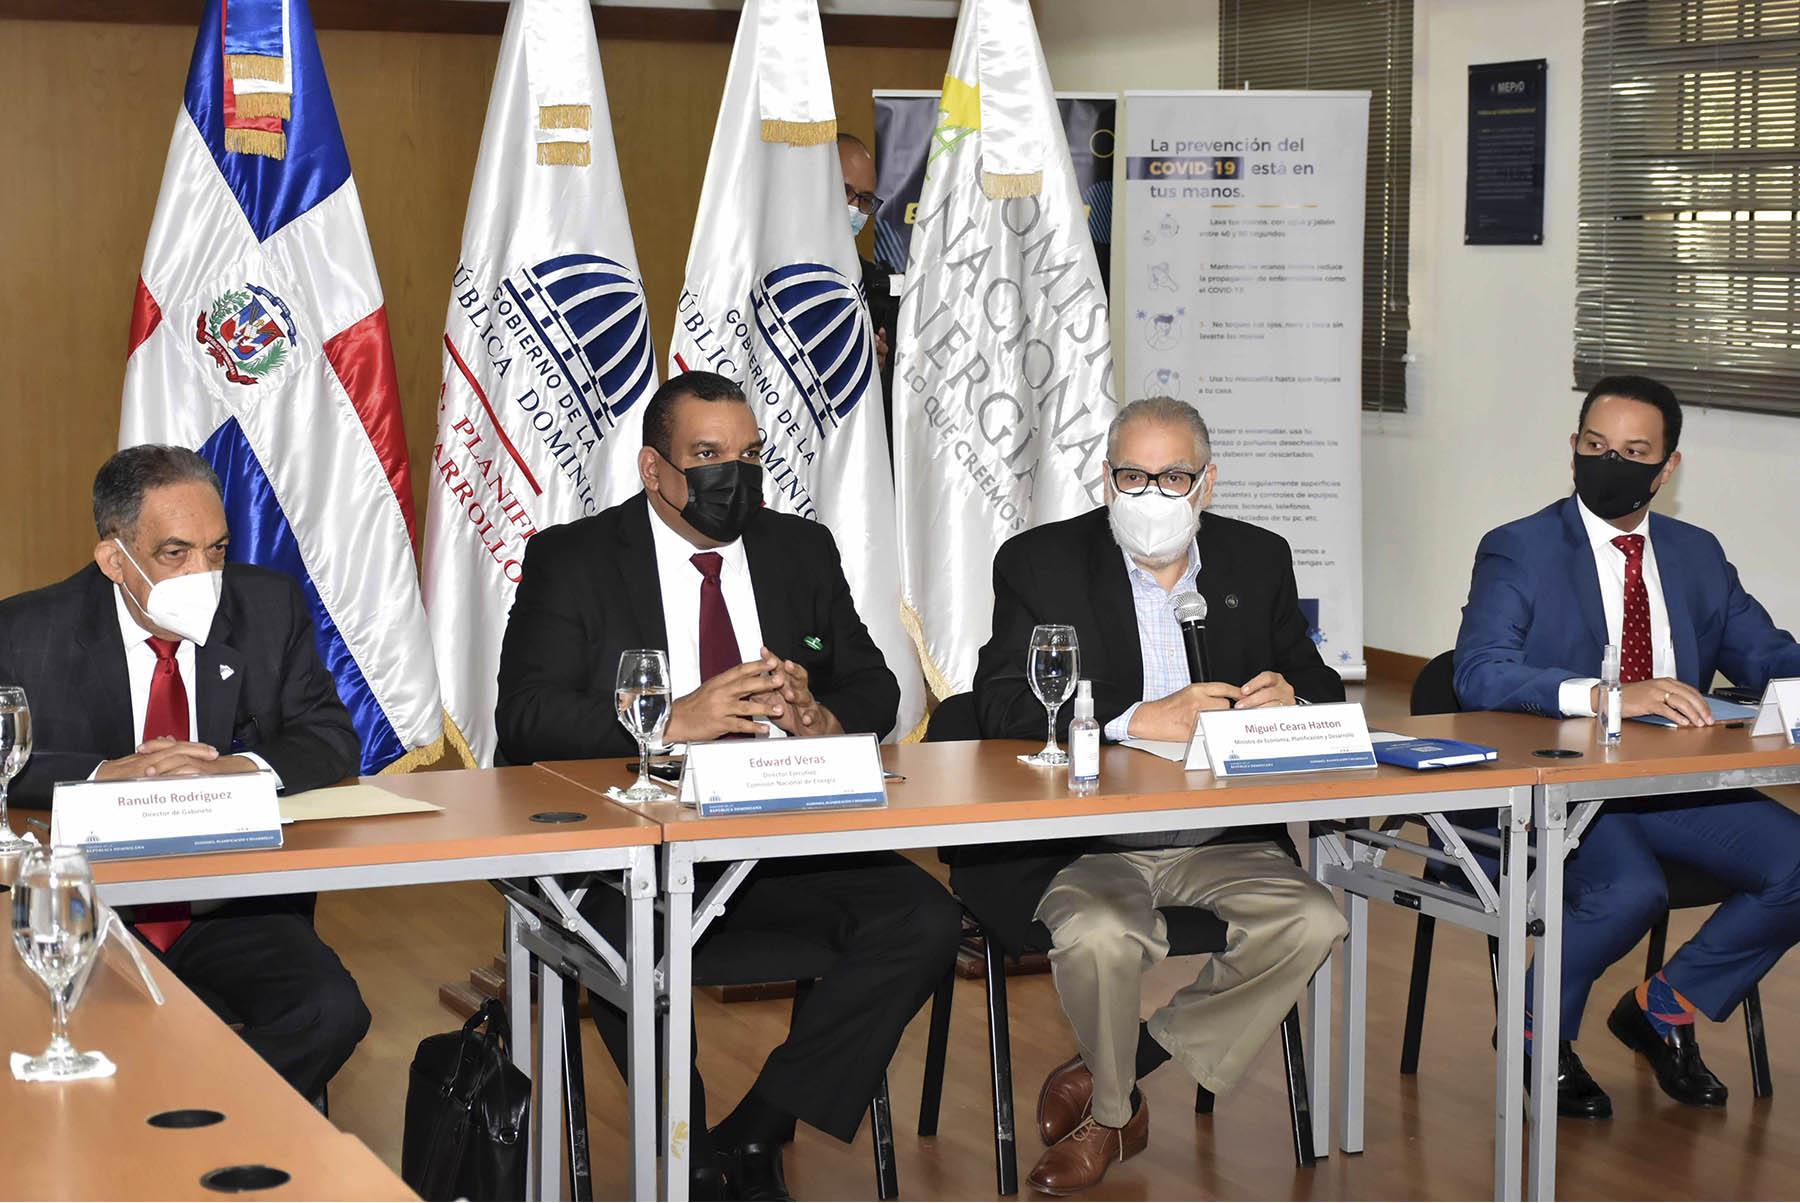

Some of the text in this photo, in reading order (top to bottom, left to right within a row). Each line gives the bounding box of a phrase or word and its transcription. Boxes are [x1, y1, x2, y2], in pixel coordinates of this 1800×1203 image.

[1150, 137, 1305, 154] La prevención del
[1150, 161, 1236, 176] COVID-19
[1293, 164, 1314, 175] en
[1150, 185, 1245, 198] tus manos.
[678, 289, 745, 389] ÚBLIC
[917, 192, 1105, 507] NACIONAL
[493, 286, 596, 454] GOBIERNO DE LA
[726, 309, 816, 466] GOBIERNO DE LA
[903, 366, 1025, 530] LO QUE CREEMOS
[452, 414, 538, 542] PLANIFI
[1244, 720, 1342, 735] Miguel Ceara Hatton
[749, 755, 826, 768] Edward Veras
[117, 793, 167, 807] Ranulfo
